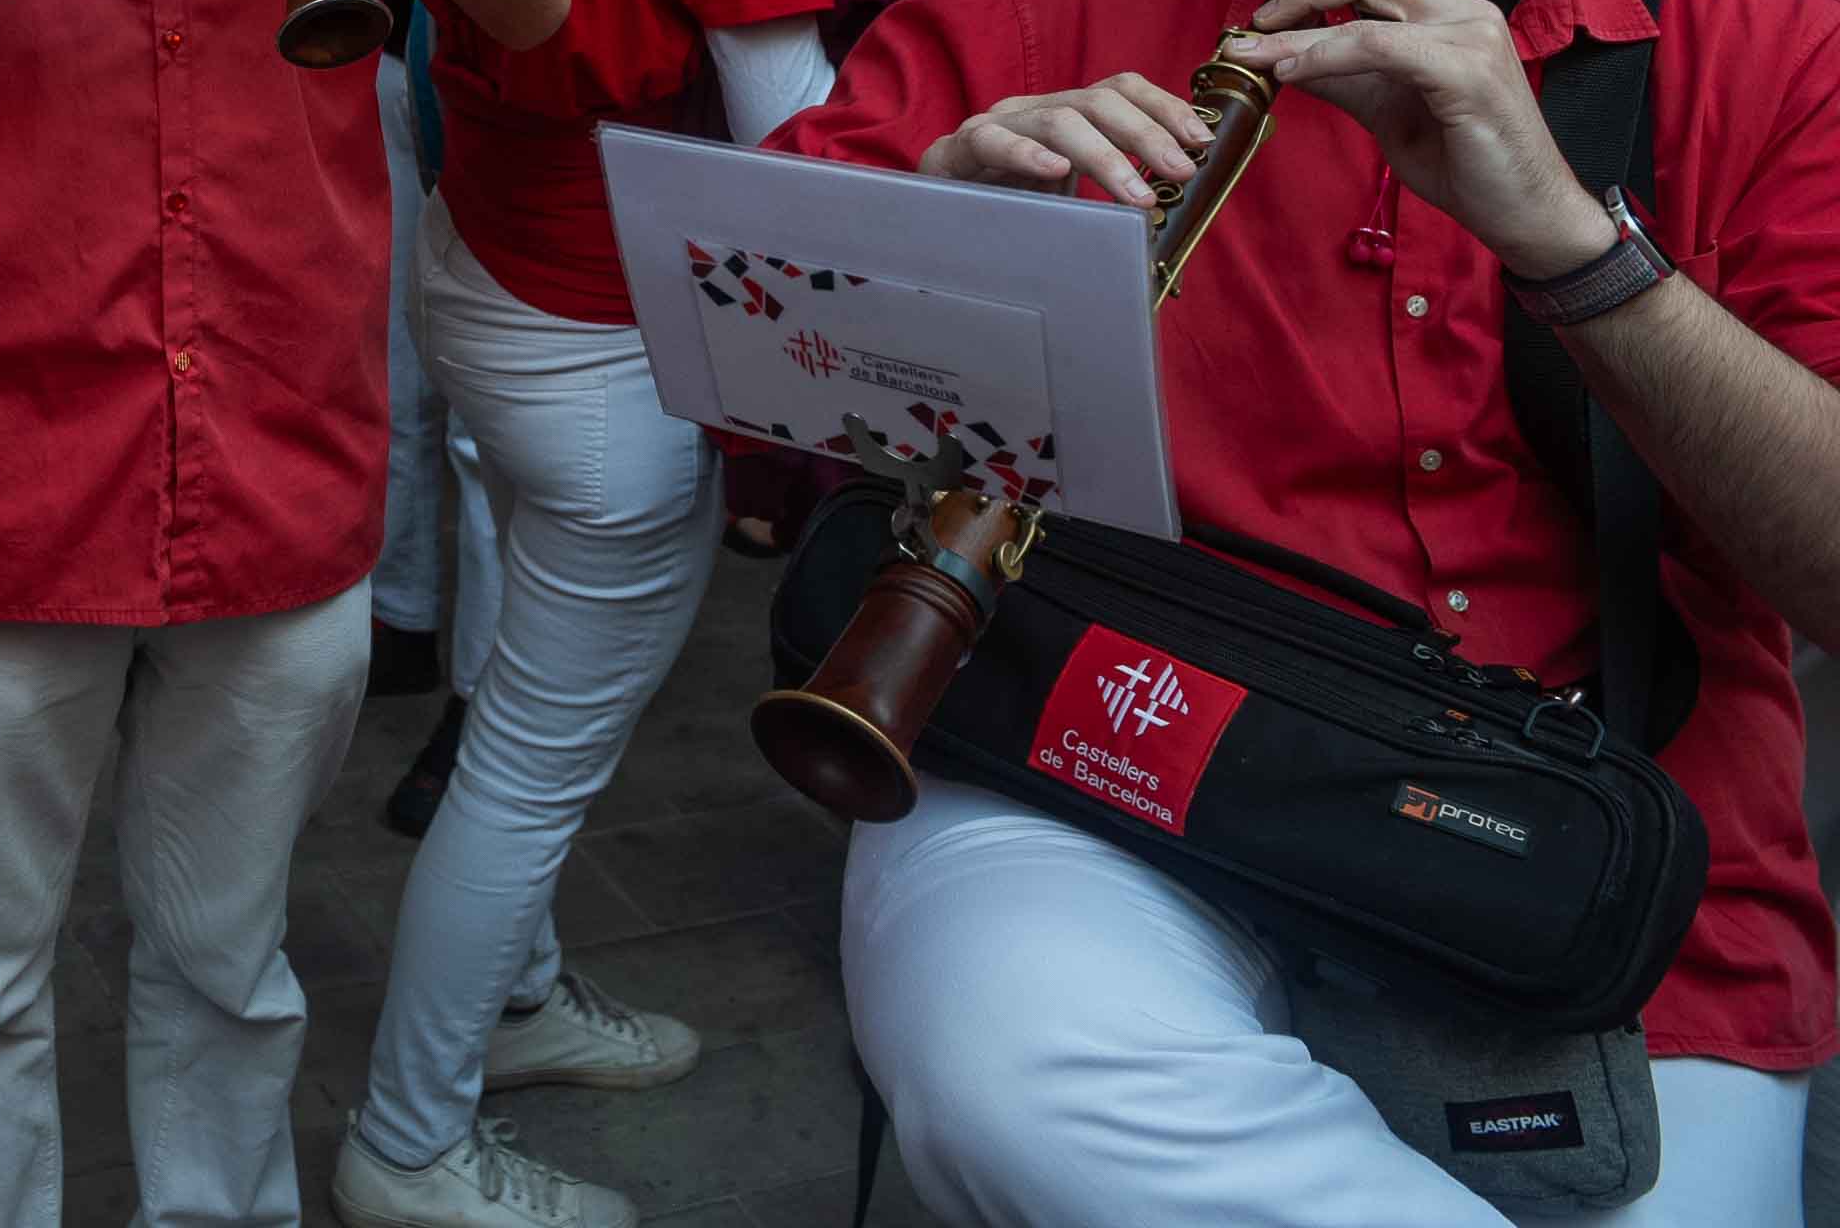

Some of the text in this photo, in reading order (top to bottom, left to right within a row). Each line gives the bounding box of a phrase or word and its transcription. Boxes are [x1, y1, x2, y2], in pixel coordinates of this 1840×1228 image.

[851, 366, 961, 402] de Barcelona
[861, 354, 945, 385] Castellers
[1062, 729, 1160, 792] Castellers
[1039, 747, 1174, 825] de Barcelona
[1439, 803, 1528, 842] protec
[1469, 1113, 1561, 1135] EASTPAK
